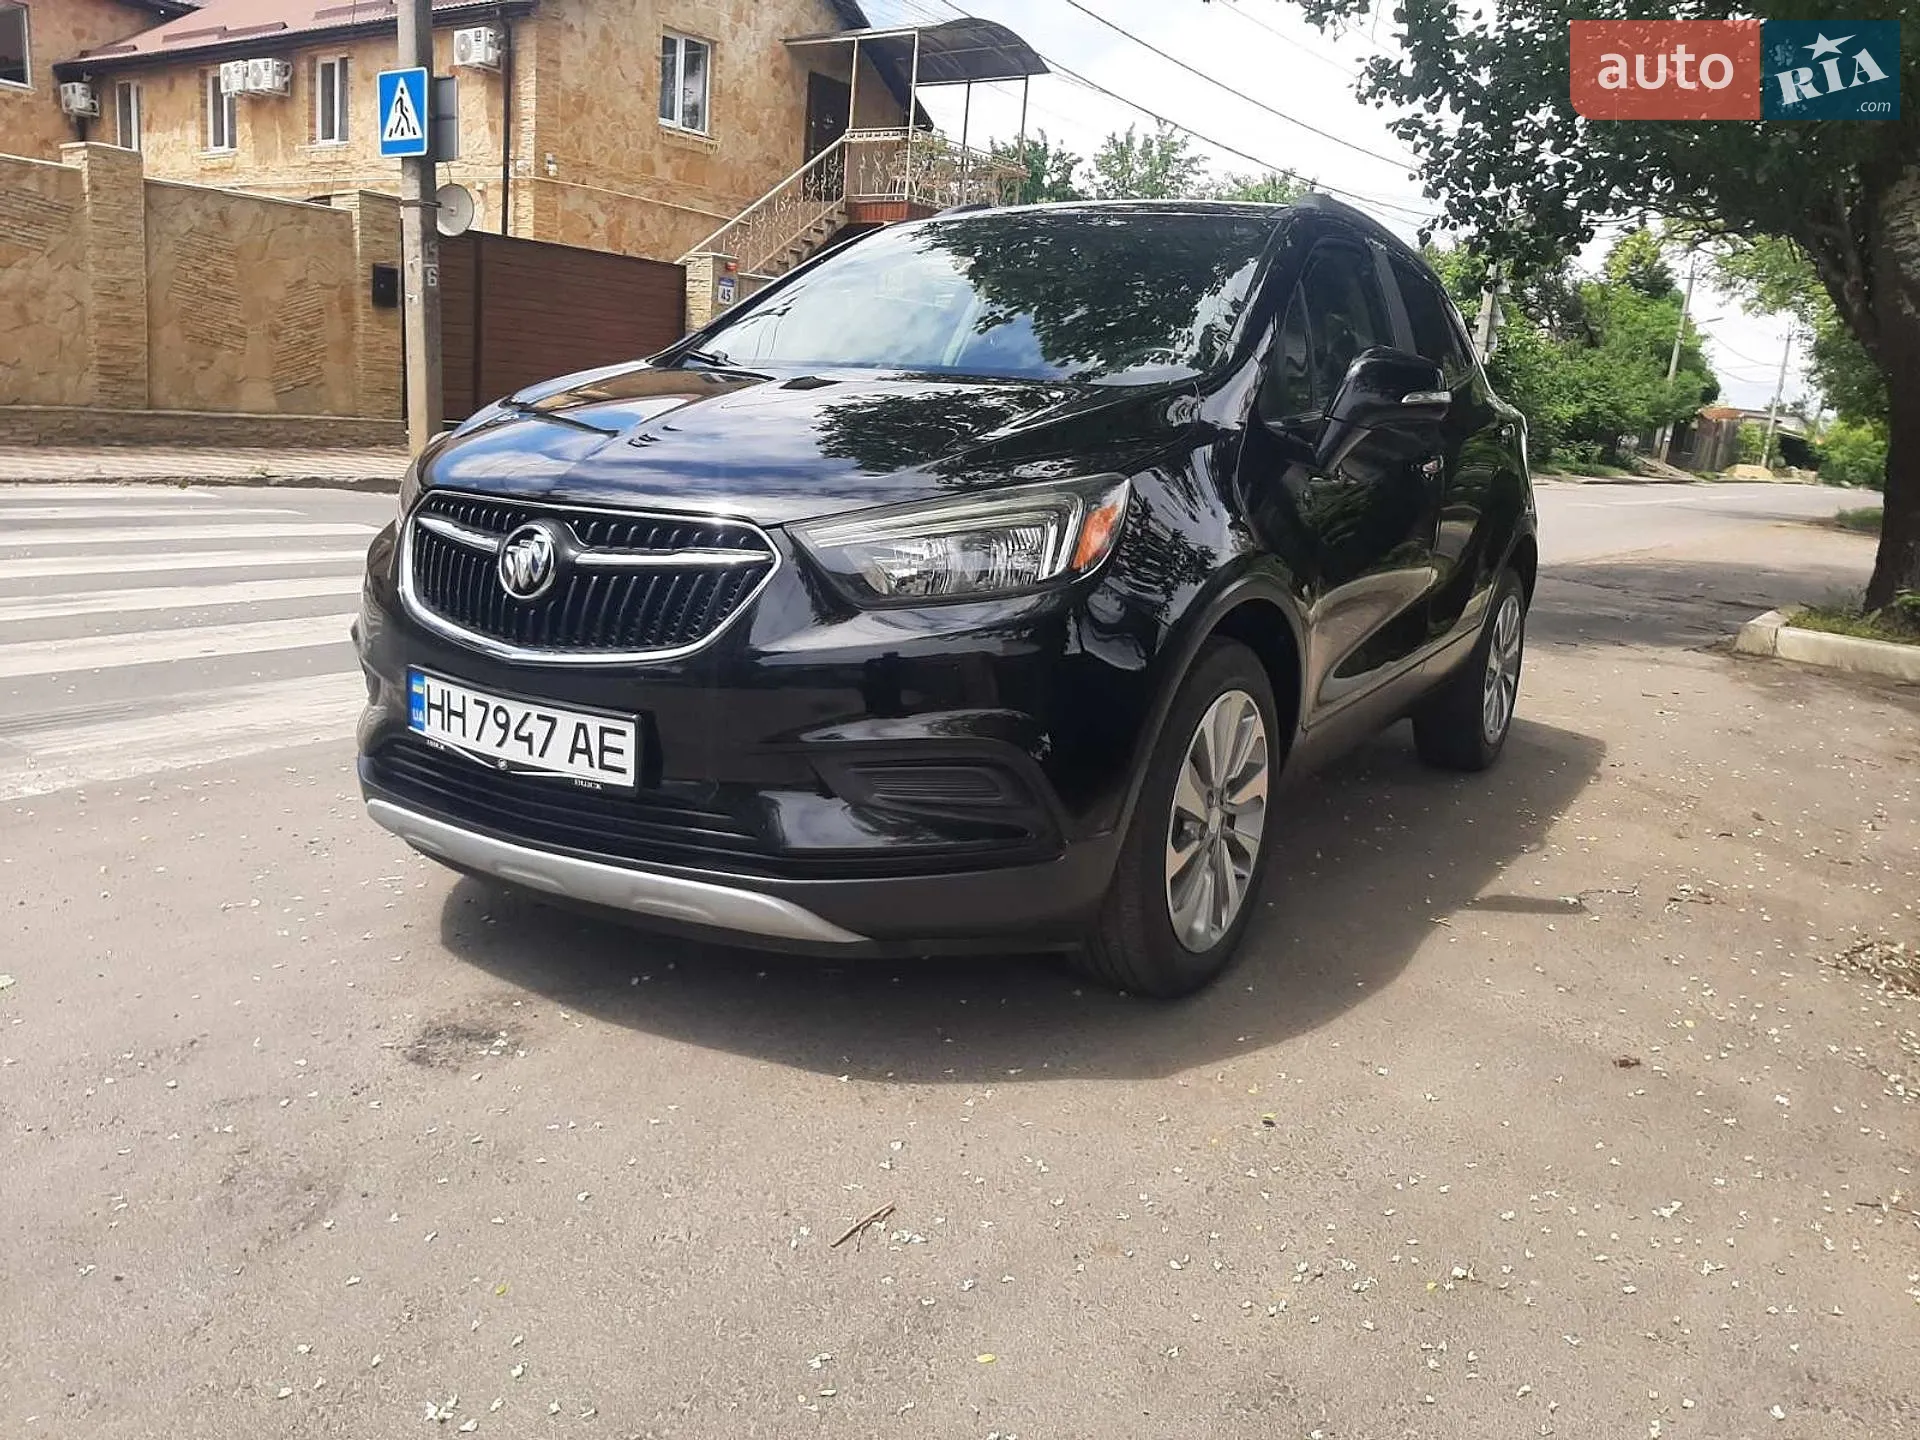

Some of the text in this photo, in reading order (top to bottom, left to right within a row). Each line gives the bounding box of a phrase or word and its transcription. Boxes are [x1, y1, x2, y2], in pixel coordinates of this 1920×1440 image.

[427, 267, 437, 287] 6
[412, 709, 424, 722] UA
[568, 722, 627, 774] AE
